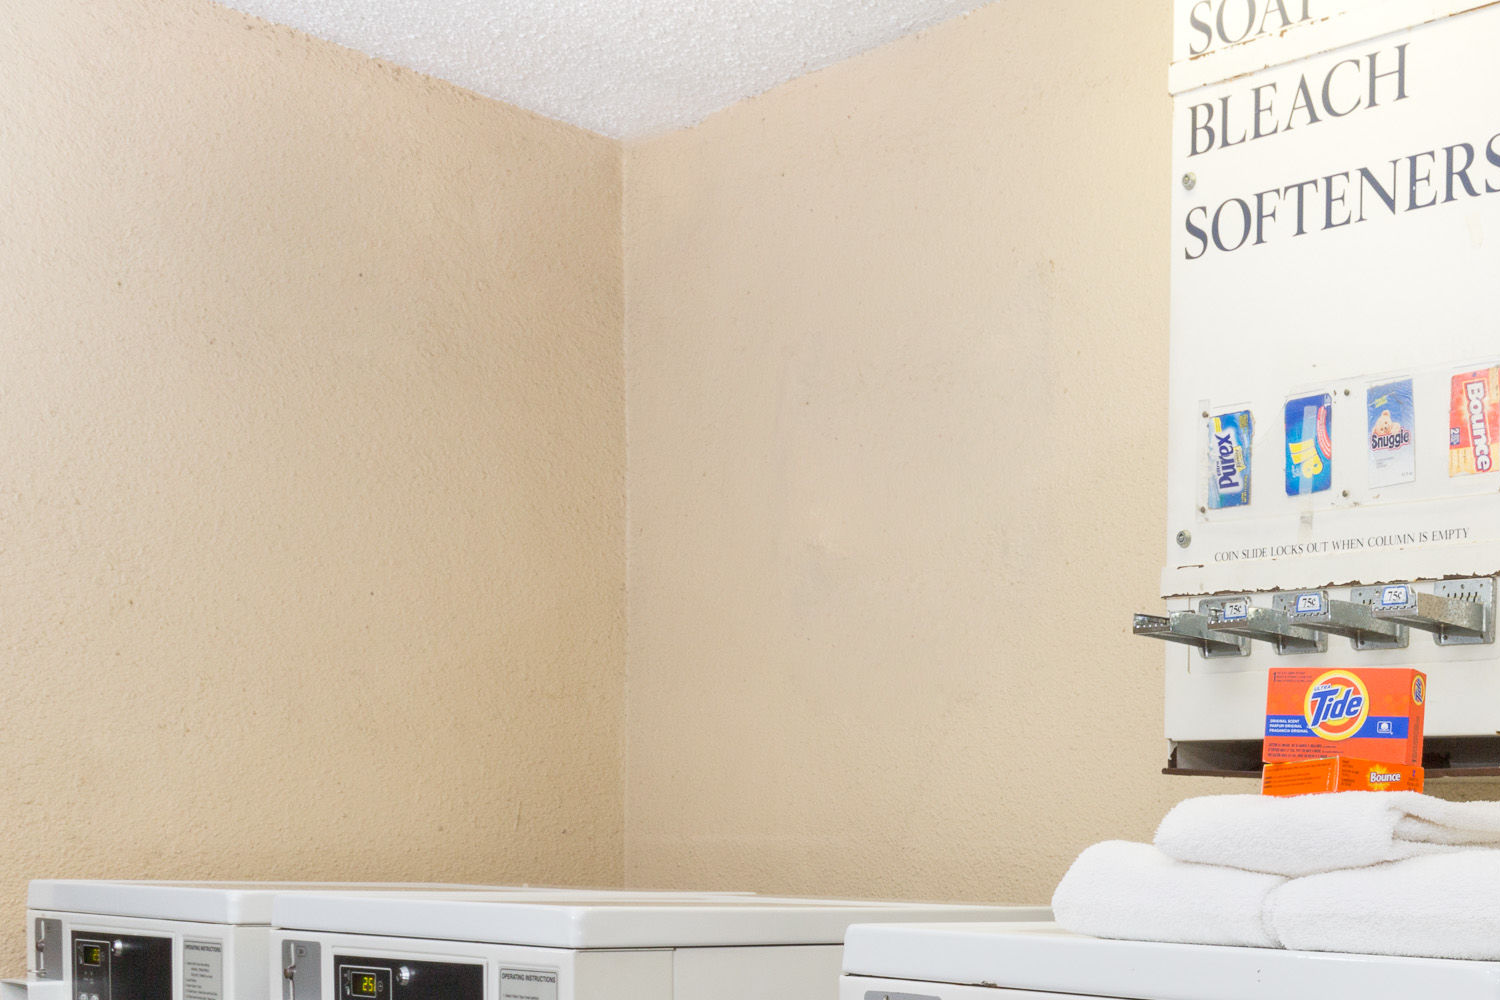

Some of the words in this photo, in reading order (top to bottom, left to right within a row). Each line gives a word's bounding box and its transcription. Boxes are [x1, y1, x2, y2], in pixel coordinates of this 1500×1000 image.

[1187, 42, 1410, 157] BLEACH
[1371, 428, 1409, 449] Snuggle
[1466, 382, 1490, 471] Bounce
[1215, 434, 1239, 488] Purex
[1215, 551, 1238, 561] COIN
[1242, 547, 1267, 559] SLIDE
[1271, 543, 1303, 556] LOCKS
[1307, 541, 1328, 553] OUT
[1332, 539, 1363, 550] WHEN
[1368, 534, 1415, 547] COLUMN
[1419, 532, 1428, 542] IS
[1432, 528, 1469, 541] EMPTY
[1302, 597, 1316, 609] 75¢
[1388, 590, 1402, 602] 75¢
[1229, 605, 1242, 615] 75¢
[1311, 688, 1363, 728] Tide
[1370, 772, 1400, 783] Bounce
